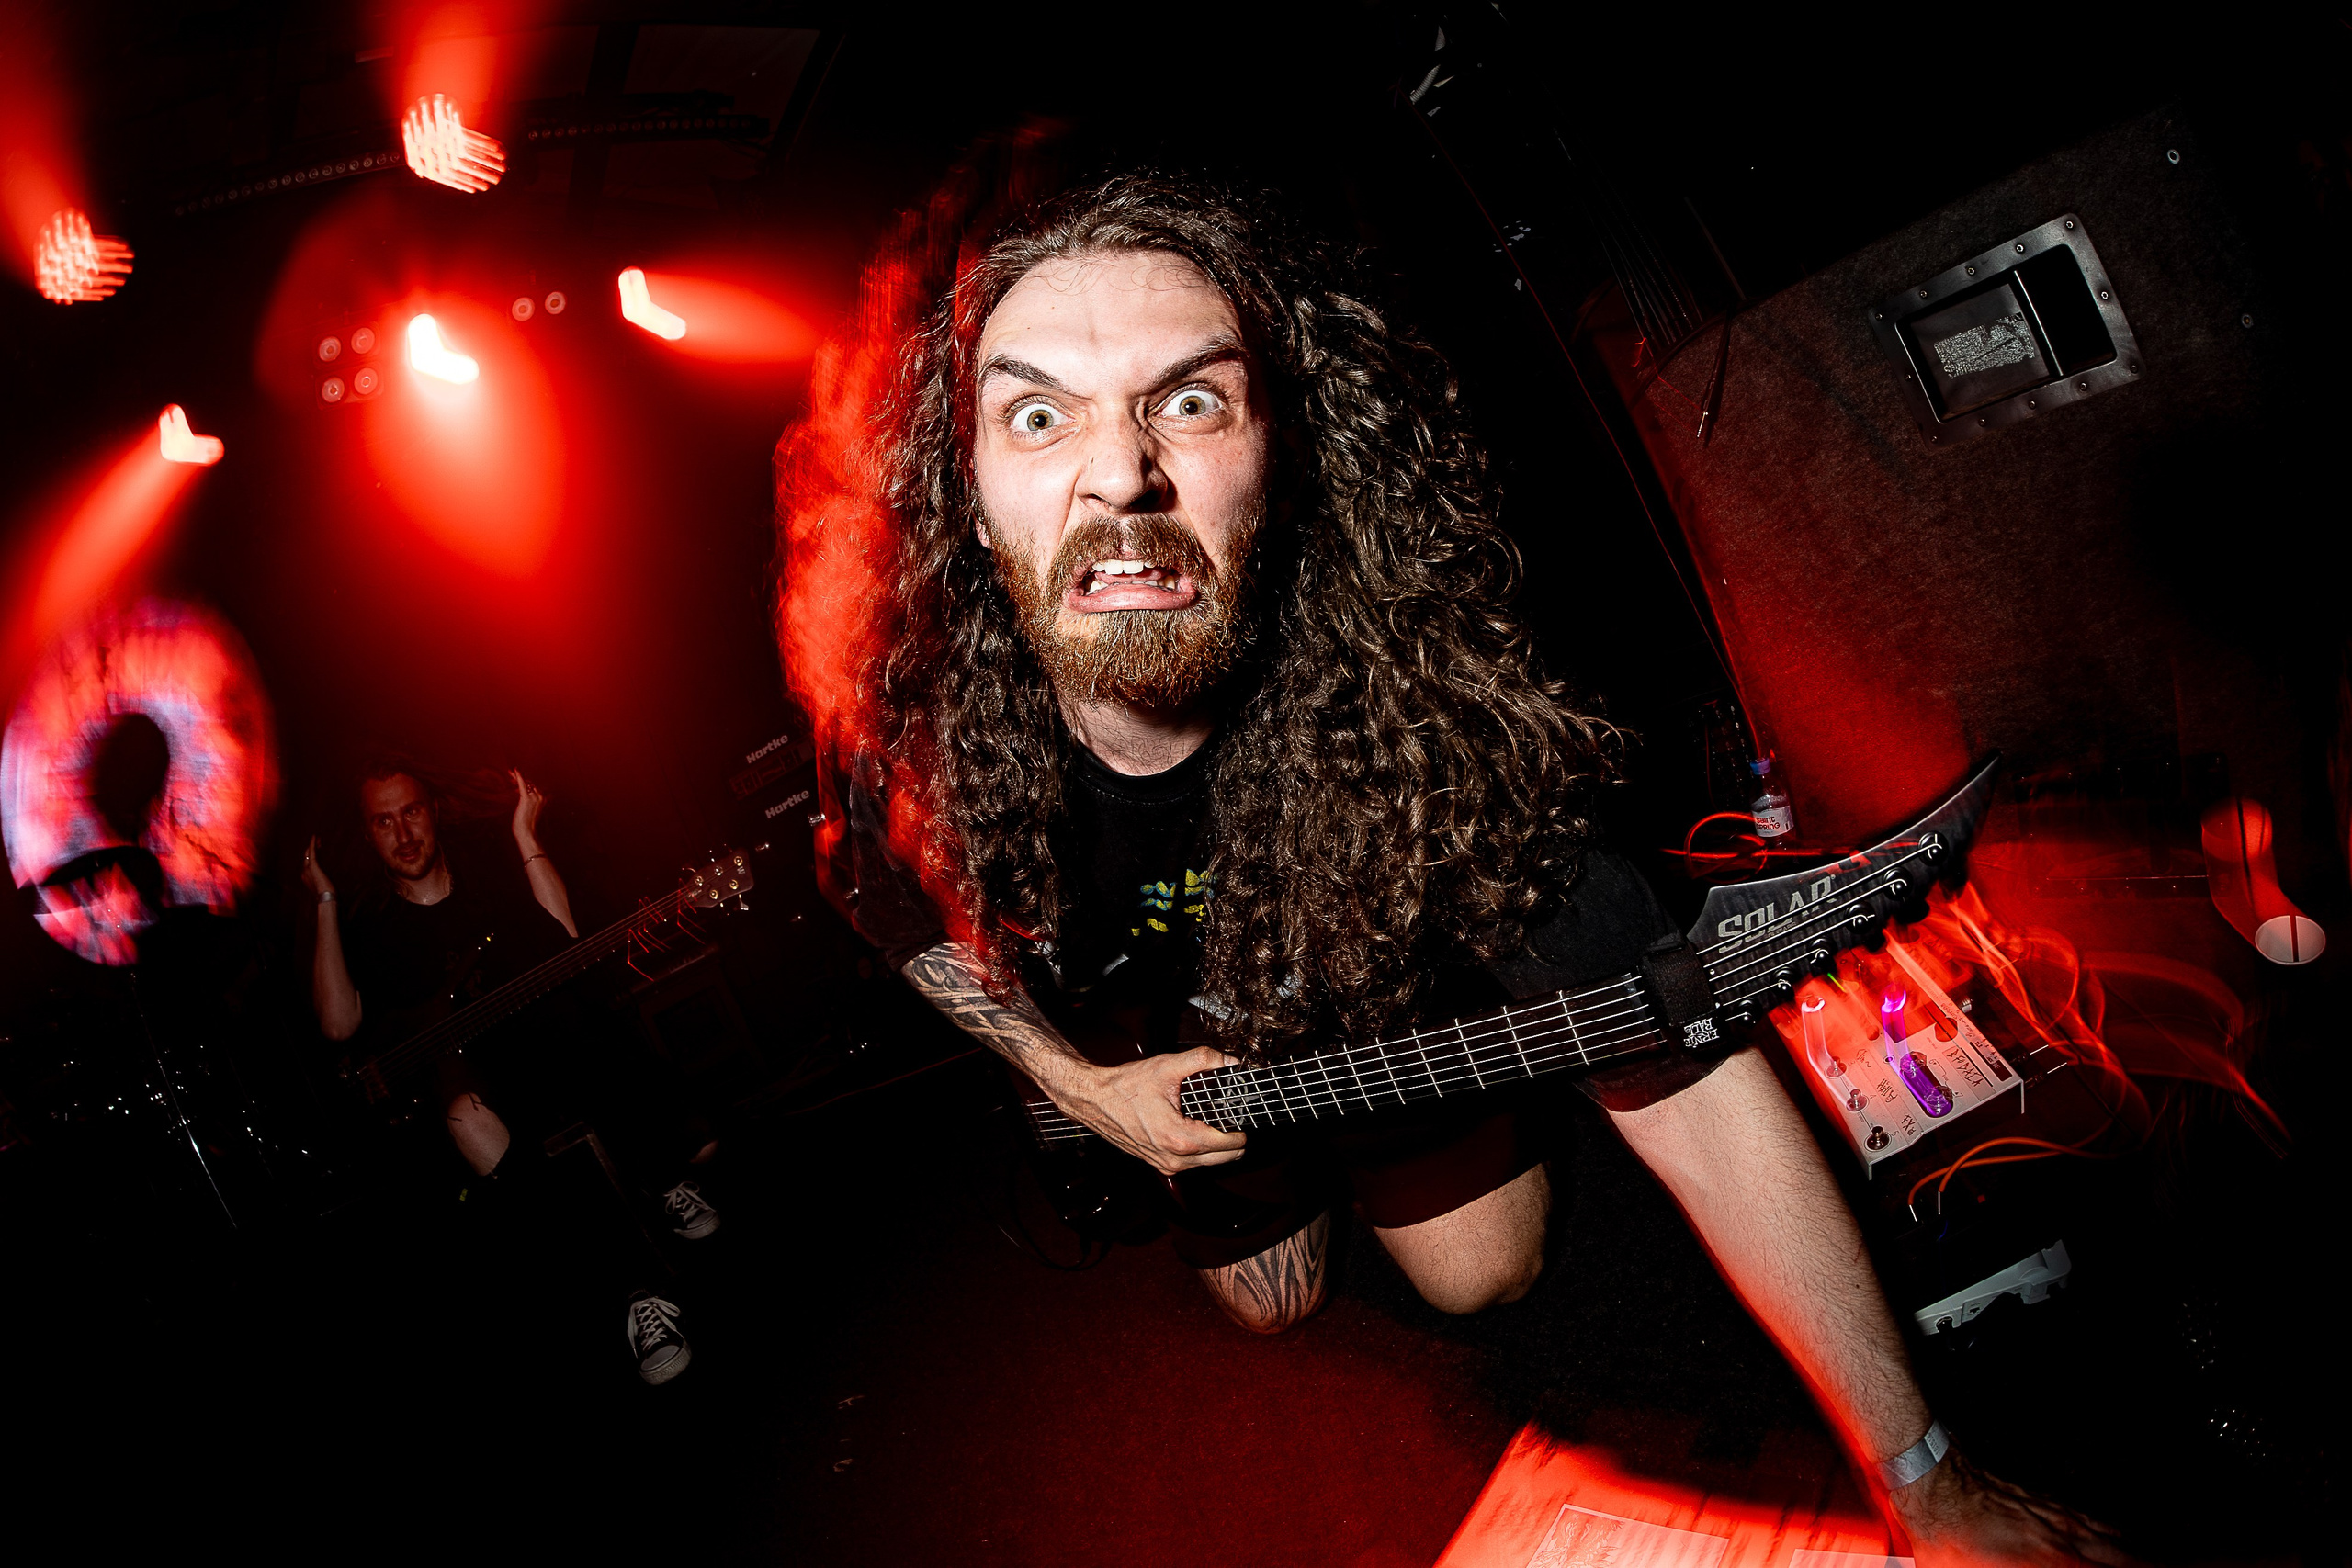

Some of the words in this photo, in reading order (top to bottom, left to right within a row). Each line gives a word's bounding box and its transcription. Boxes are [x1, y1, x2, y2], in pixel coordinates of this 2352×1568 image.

[746, 734, 789, 764] Hartke
[764, 790, 809, 819] Hartke
[1718, 875, 1838, 953] SOLAR
[1683, 1028, 1720, 1048] ERNIE
[1684, 1017, 1714, 1037] BALL
